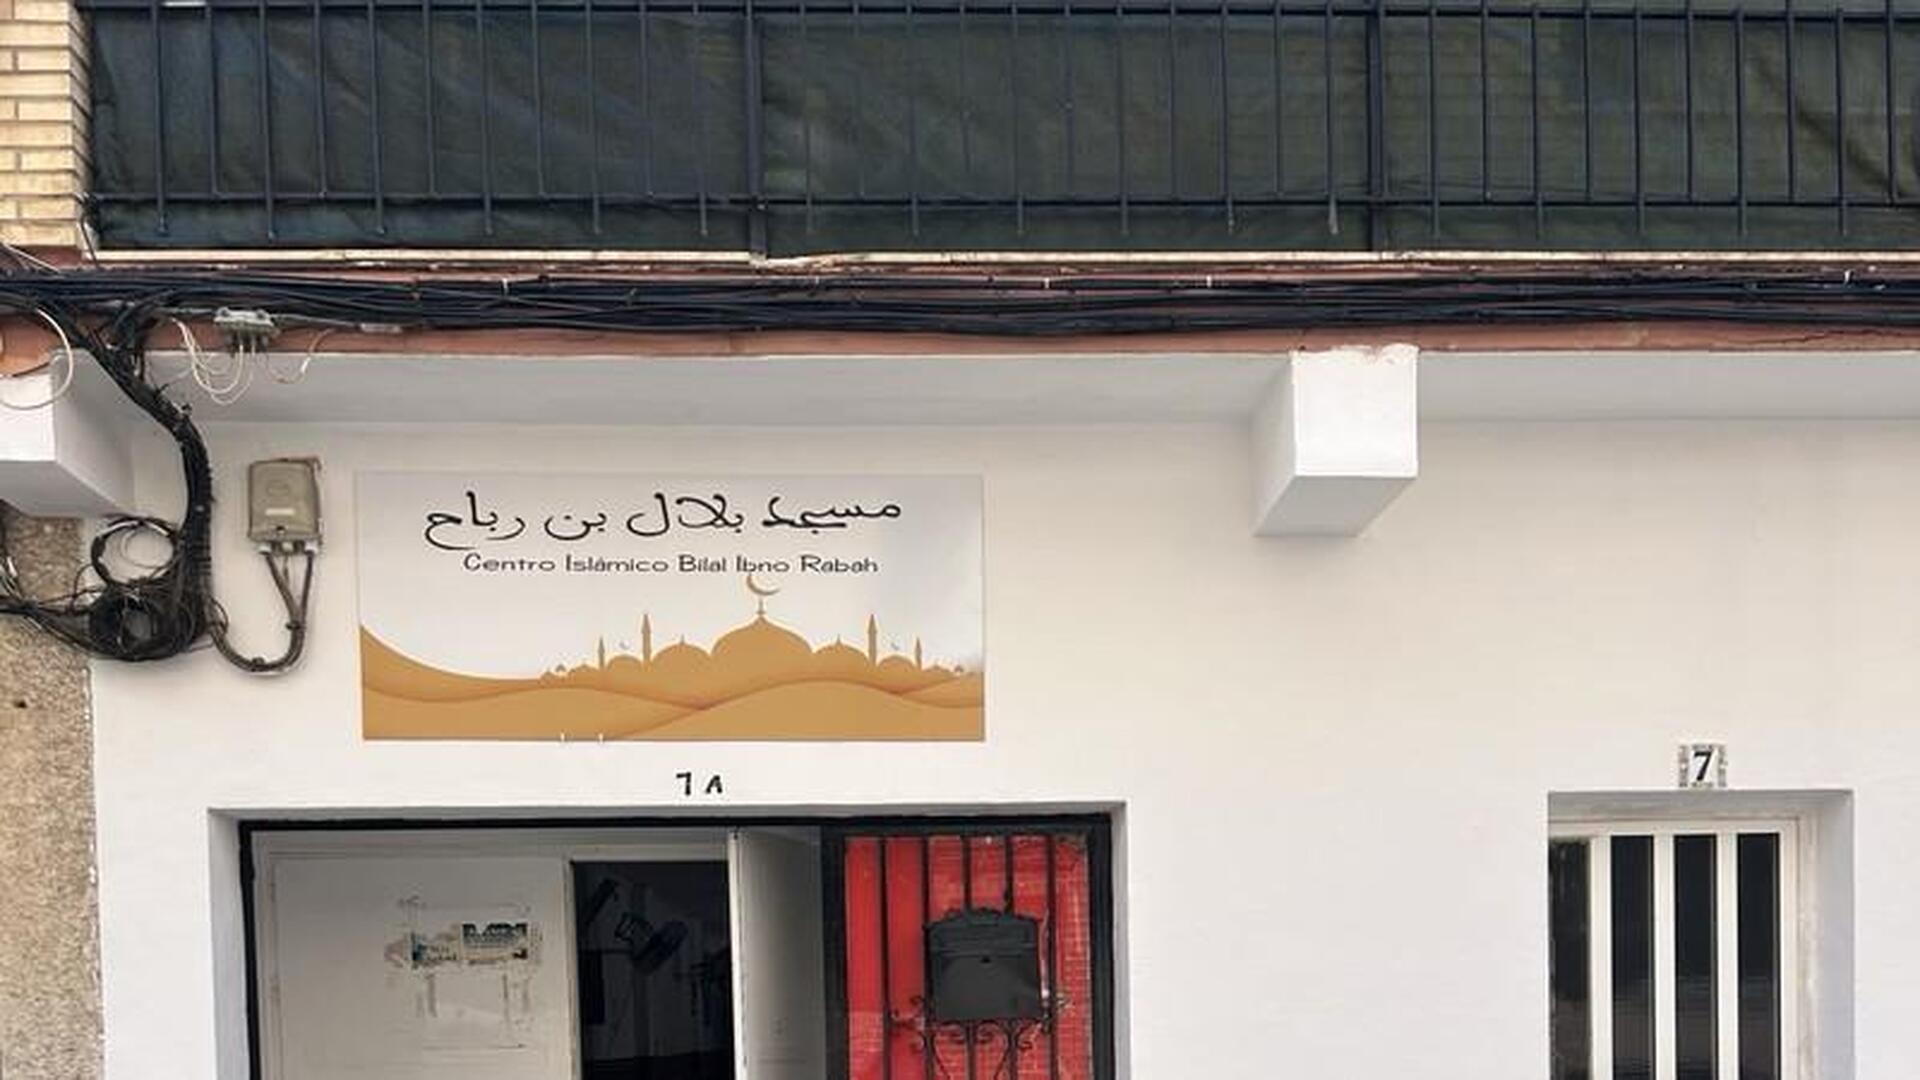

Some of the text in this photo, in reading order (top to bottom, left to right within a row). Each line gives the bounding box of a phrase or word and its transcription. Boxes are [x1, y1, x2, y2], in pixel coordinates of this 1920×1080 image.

[424, 490, 902, 551] مسجد بلال بن رباح
[463, 553, 879, 573] Centro Islámico Bilal Ibno Rabah
[1694, 750, 1712, 782] 7
